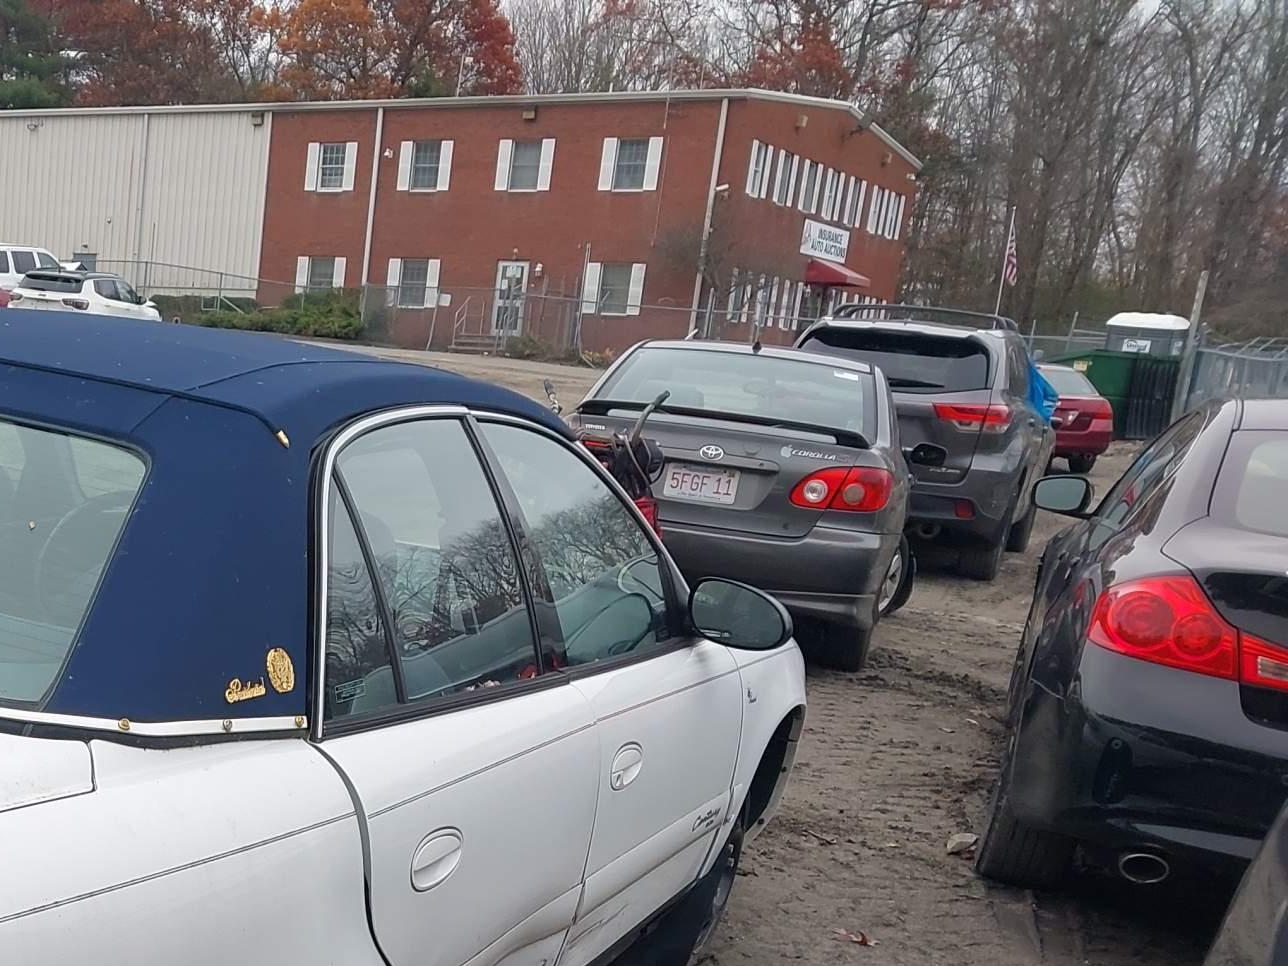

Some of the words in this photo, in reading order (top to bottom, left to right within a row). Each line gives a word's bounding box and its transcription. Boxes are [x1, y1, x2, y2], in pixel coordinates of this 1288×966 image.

[818, 228, 843, 245] INSURANCE
[811, 239, 824, 252] AUTO
[792, 449, 836, 460] COROLLA
[670, 472, 711, 493] 5FGF
[713, 477, 732, 496] 11
